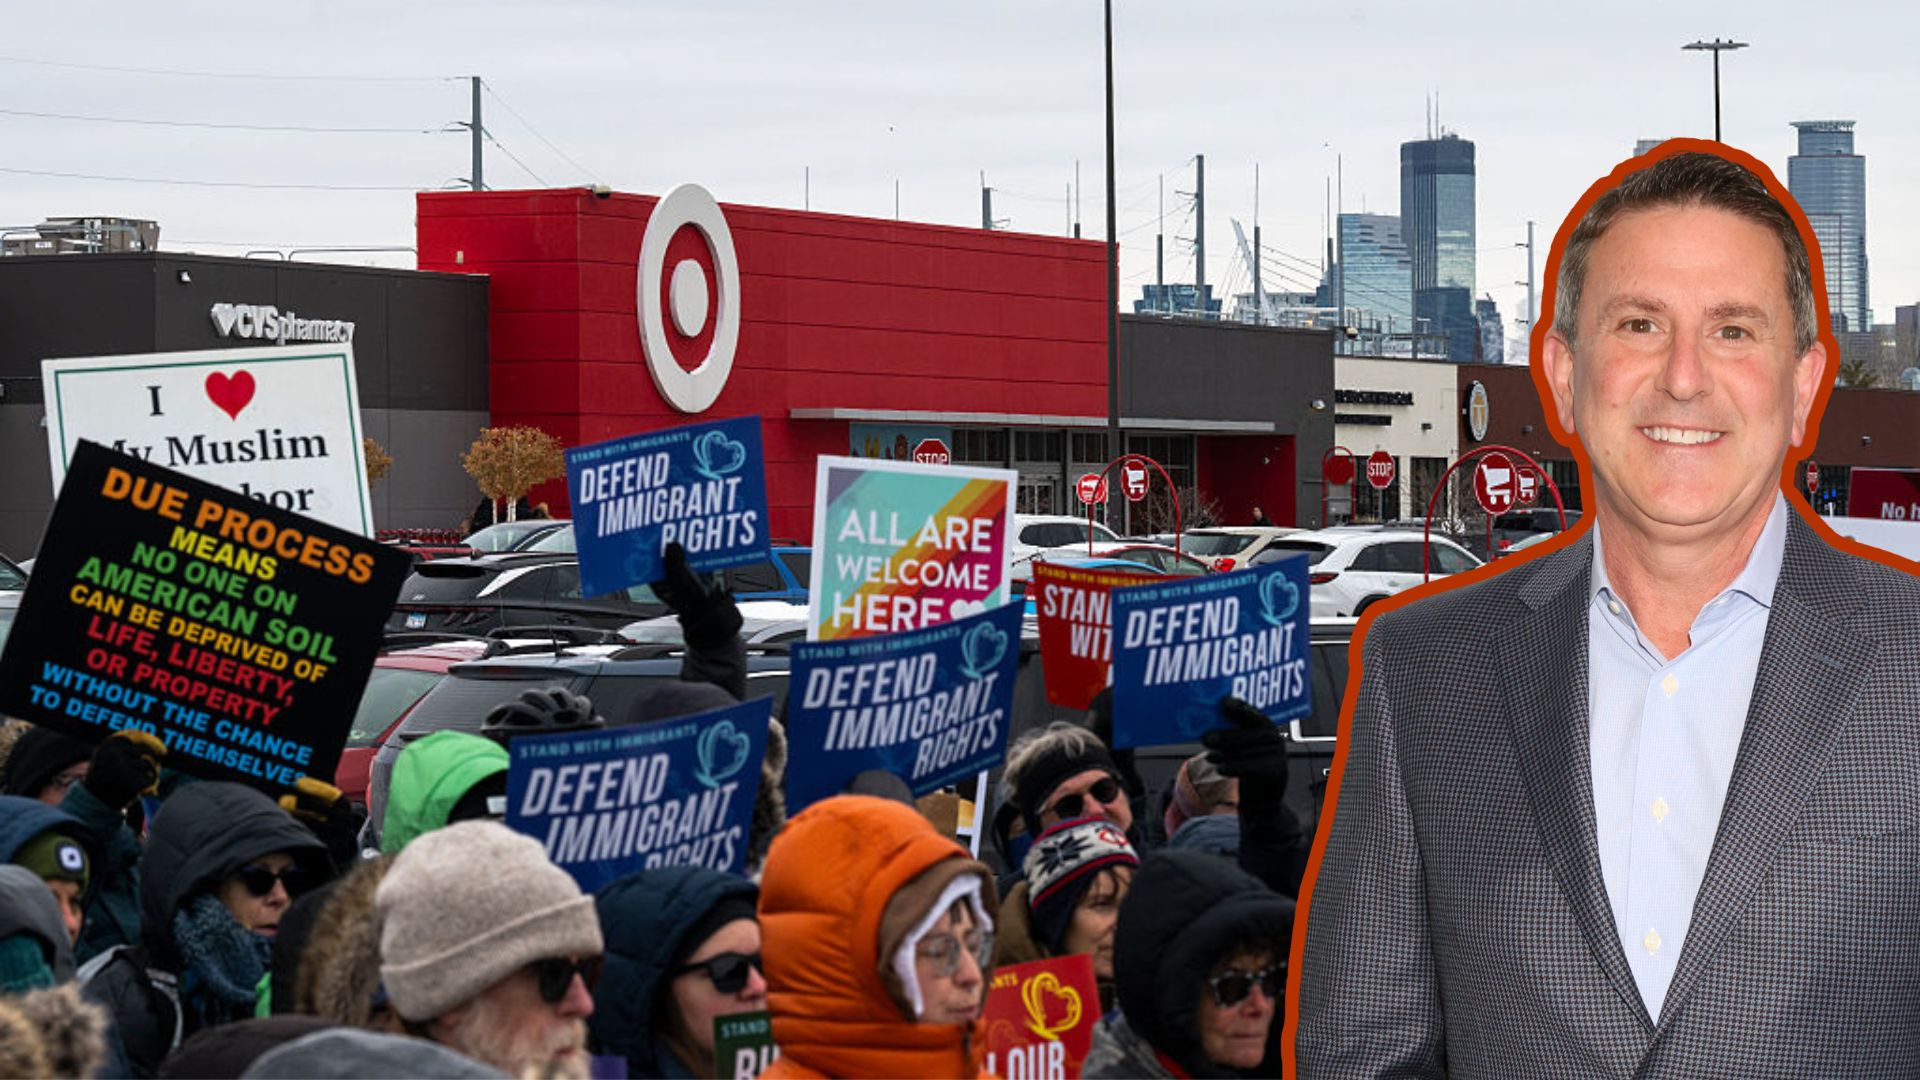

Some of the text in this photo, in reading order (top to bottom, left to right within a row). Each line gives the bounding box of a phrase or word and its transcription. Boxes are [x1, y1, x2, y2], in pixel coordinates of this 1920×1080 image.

[146, 386, 164, 415] I
[111, 428, 329, 467] y Muslim
[571, 431, 691, 464] STAND WITH IMMIGRANTS
[916, 453, 948, 465] STOP
[1368, 462, 1392, 477] STOP
[579, 452, 670, 506] DEFEND
[101, 468, 189, 522] DUE
[194, 499, 376, 585] PROCESS
[597, 476, 742, 538] IMMIGRANT
[837, 508, 993, 553] ALL ARE
[168, 526, 280, 581] MEANS
[660, 510, 758, 558] RIGHTS
[131, 542, 299, 616] NO ONE ON
[836, 554, 991, 592] WELCOME
[1038, 565, 1068, 581] STAND
[1069, 571, 1095, 585] WITH
[1118, 573, 1258, 604] STAND WITH IMMIGRANTS
[76, 556, 338, 664] AMERICAN SOIL
[831, 591, 944, 633] HERE
[1043, 584, 1113, 625] STAN
[1123, 596, 1240, 649] DEFEND
[69, 584, 328, 684] CAN BE DEPRIVED OF
[87, 614, 295, 706] LIFE, LIBERTY,
[799, 625, 962, 660] STAND WITH IMMIGRANTS
[1070, 623, 1113, 662] WIT
[1143, 622, 1296, 687] IMMIGRANT
[86, 647, 281, 727] OR PROPERTY
[802, 652, 937, 710] DEFEND
[1231, 659, 1305, 710] RIGHTS
[29, 684, 62, 710] TO
[65, 696, 156, 736] DEFEND
[41, 661, 314, 767] WITHOUT THE CHANCE
[824, 671, 999, 751] IMMIGRANT
[520, 723, 698, 759] STAND WITH IMMIGRANTS
[912, 708, 1004, 780] RIGHTS
[521, 753, 670, 817] DEFEND
[546, 782, 739, 864] IMMIGRANT
[721, 1019, 768, 1039] STAND
